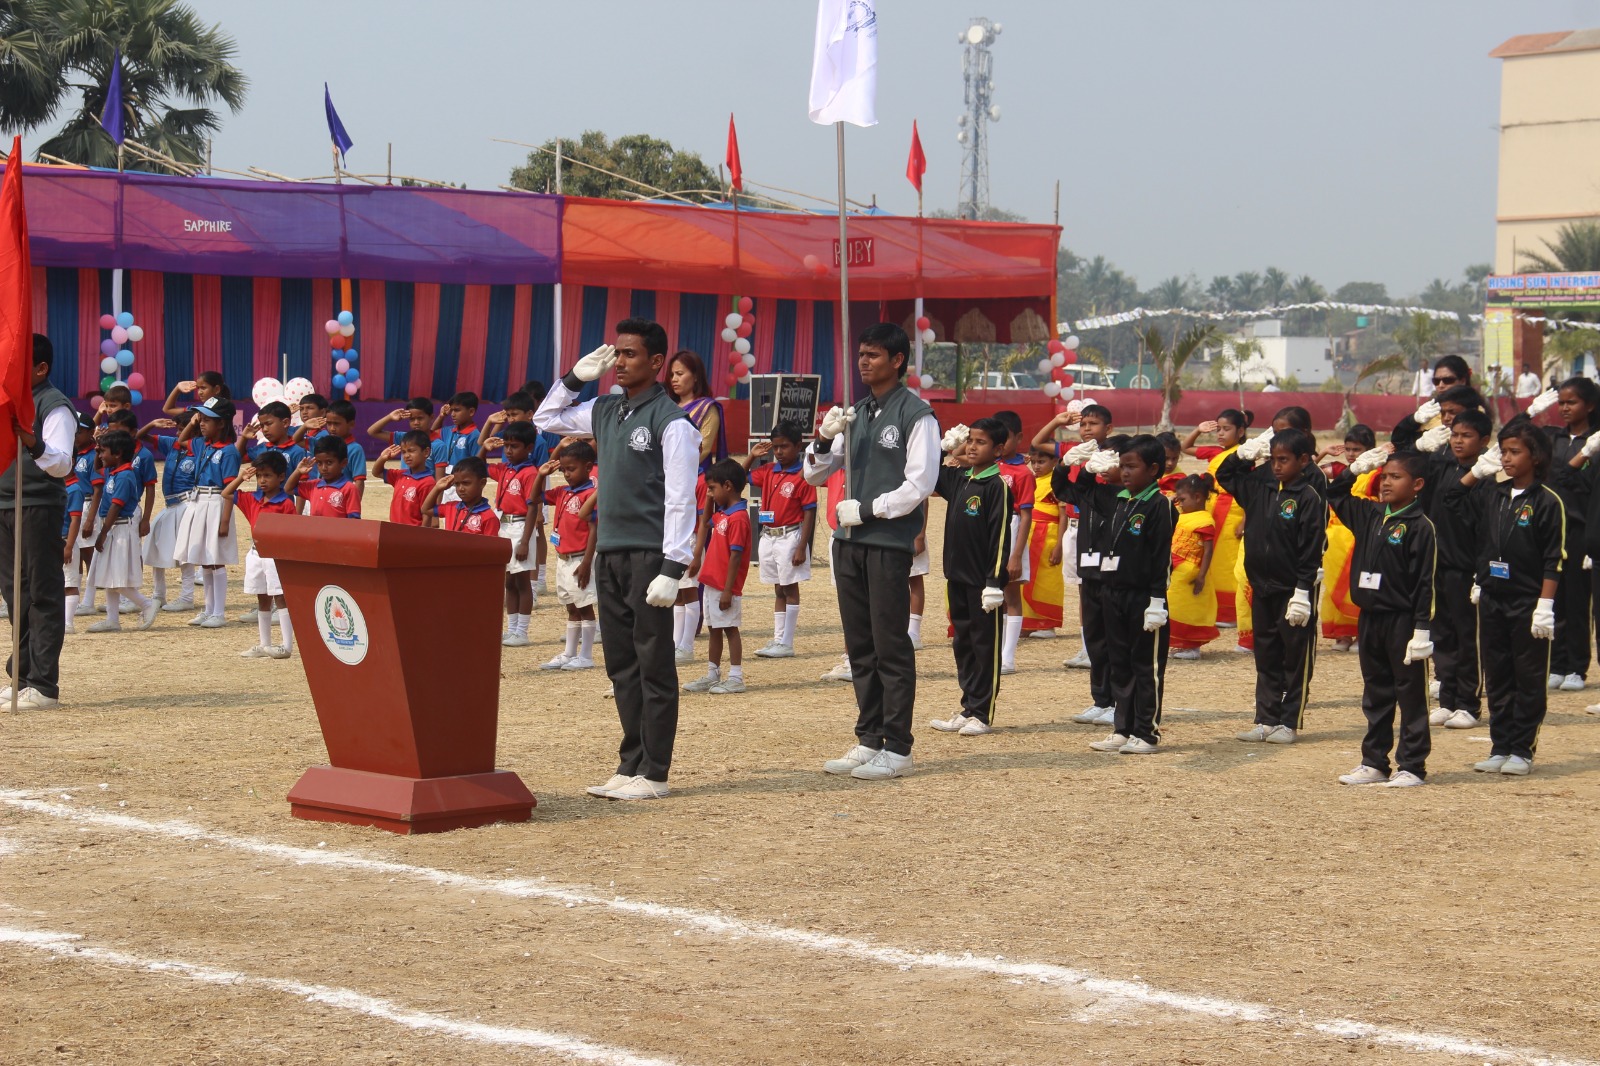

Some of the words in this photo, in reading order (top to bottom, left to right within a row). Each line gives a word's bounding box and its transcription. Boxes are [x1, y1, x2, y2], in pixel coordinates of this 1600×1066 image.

[184, 219, 232, 232] SAPPHIRE
[1489, 277, 1523, 288] RISING
[1527, 277, 1547, 287] SUN
